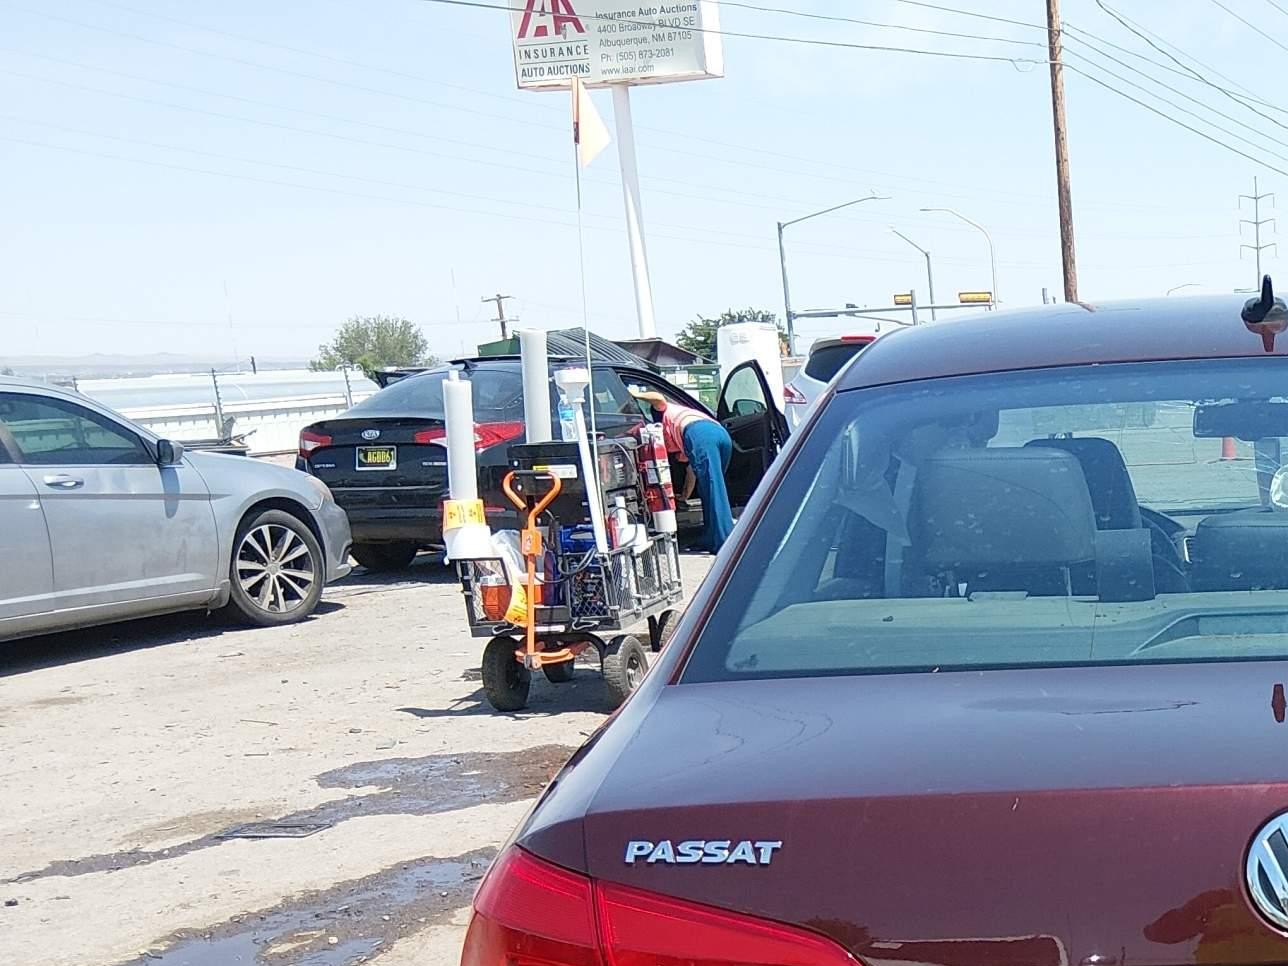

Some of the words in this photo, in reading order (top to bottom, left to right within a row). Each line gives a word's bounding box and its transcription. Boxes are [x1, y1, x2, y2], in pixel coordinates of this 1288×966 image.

[595, 10, 636, 20] Insurance
[638, 7, 657, 17] Auto
[660, 4, 698, 14] Auctions
[597, 24, 617, 33] 4400
[618, 22, 657, 33] Broadway
[658, 17, 681, 28] BLVD
[683, 16, 695, 26] SE
[651, 32, 666, 42] NM
[667, 31, 692, 41] 87105
[518, 44, 589, 60] INSURANCE
[616, 51, 637, 63] (505)
[521, 66, 545, 78] AUTO
[547, 62, 591, 76] AUCTIONS
[624, 840, 783, 865] PASSAT
